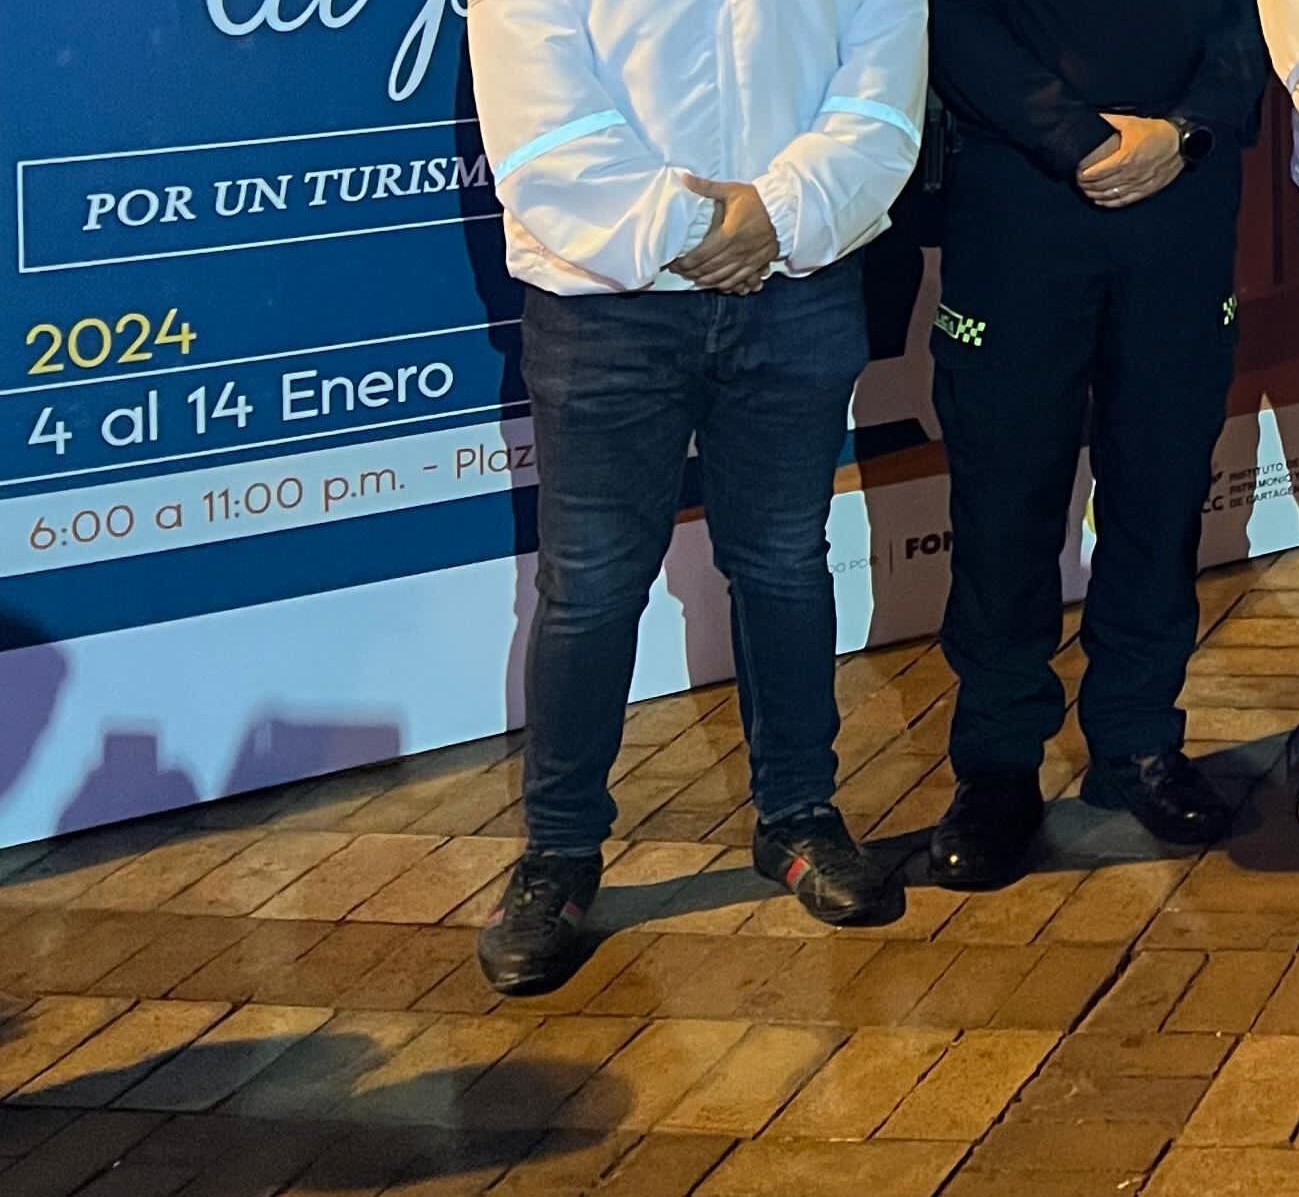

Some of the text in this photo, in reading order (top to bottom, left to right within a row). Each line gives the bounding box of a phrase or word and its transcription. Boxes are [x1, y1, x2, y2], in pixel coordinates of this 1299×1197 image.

[82, 187, 196, 231] POR
[214, 174, 290, 217] UN
[25, 308, 198, 377] 2024
[28, 360, 455, 456] 4 al 14 Enero
[29, 502, 135, 553] 6:00
[154, 500, 184, 532] a
[203, 475, 305, 525] 11:00
[323, 464, 407, 513] p.m.
